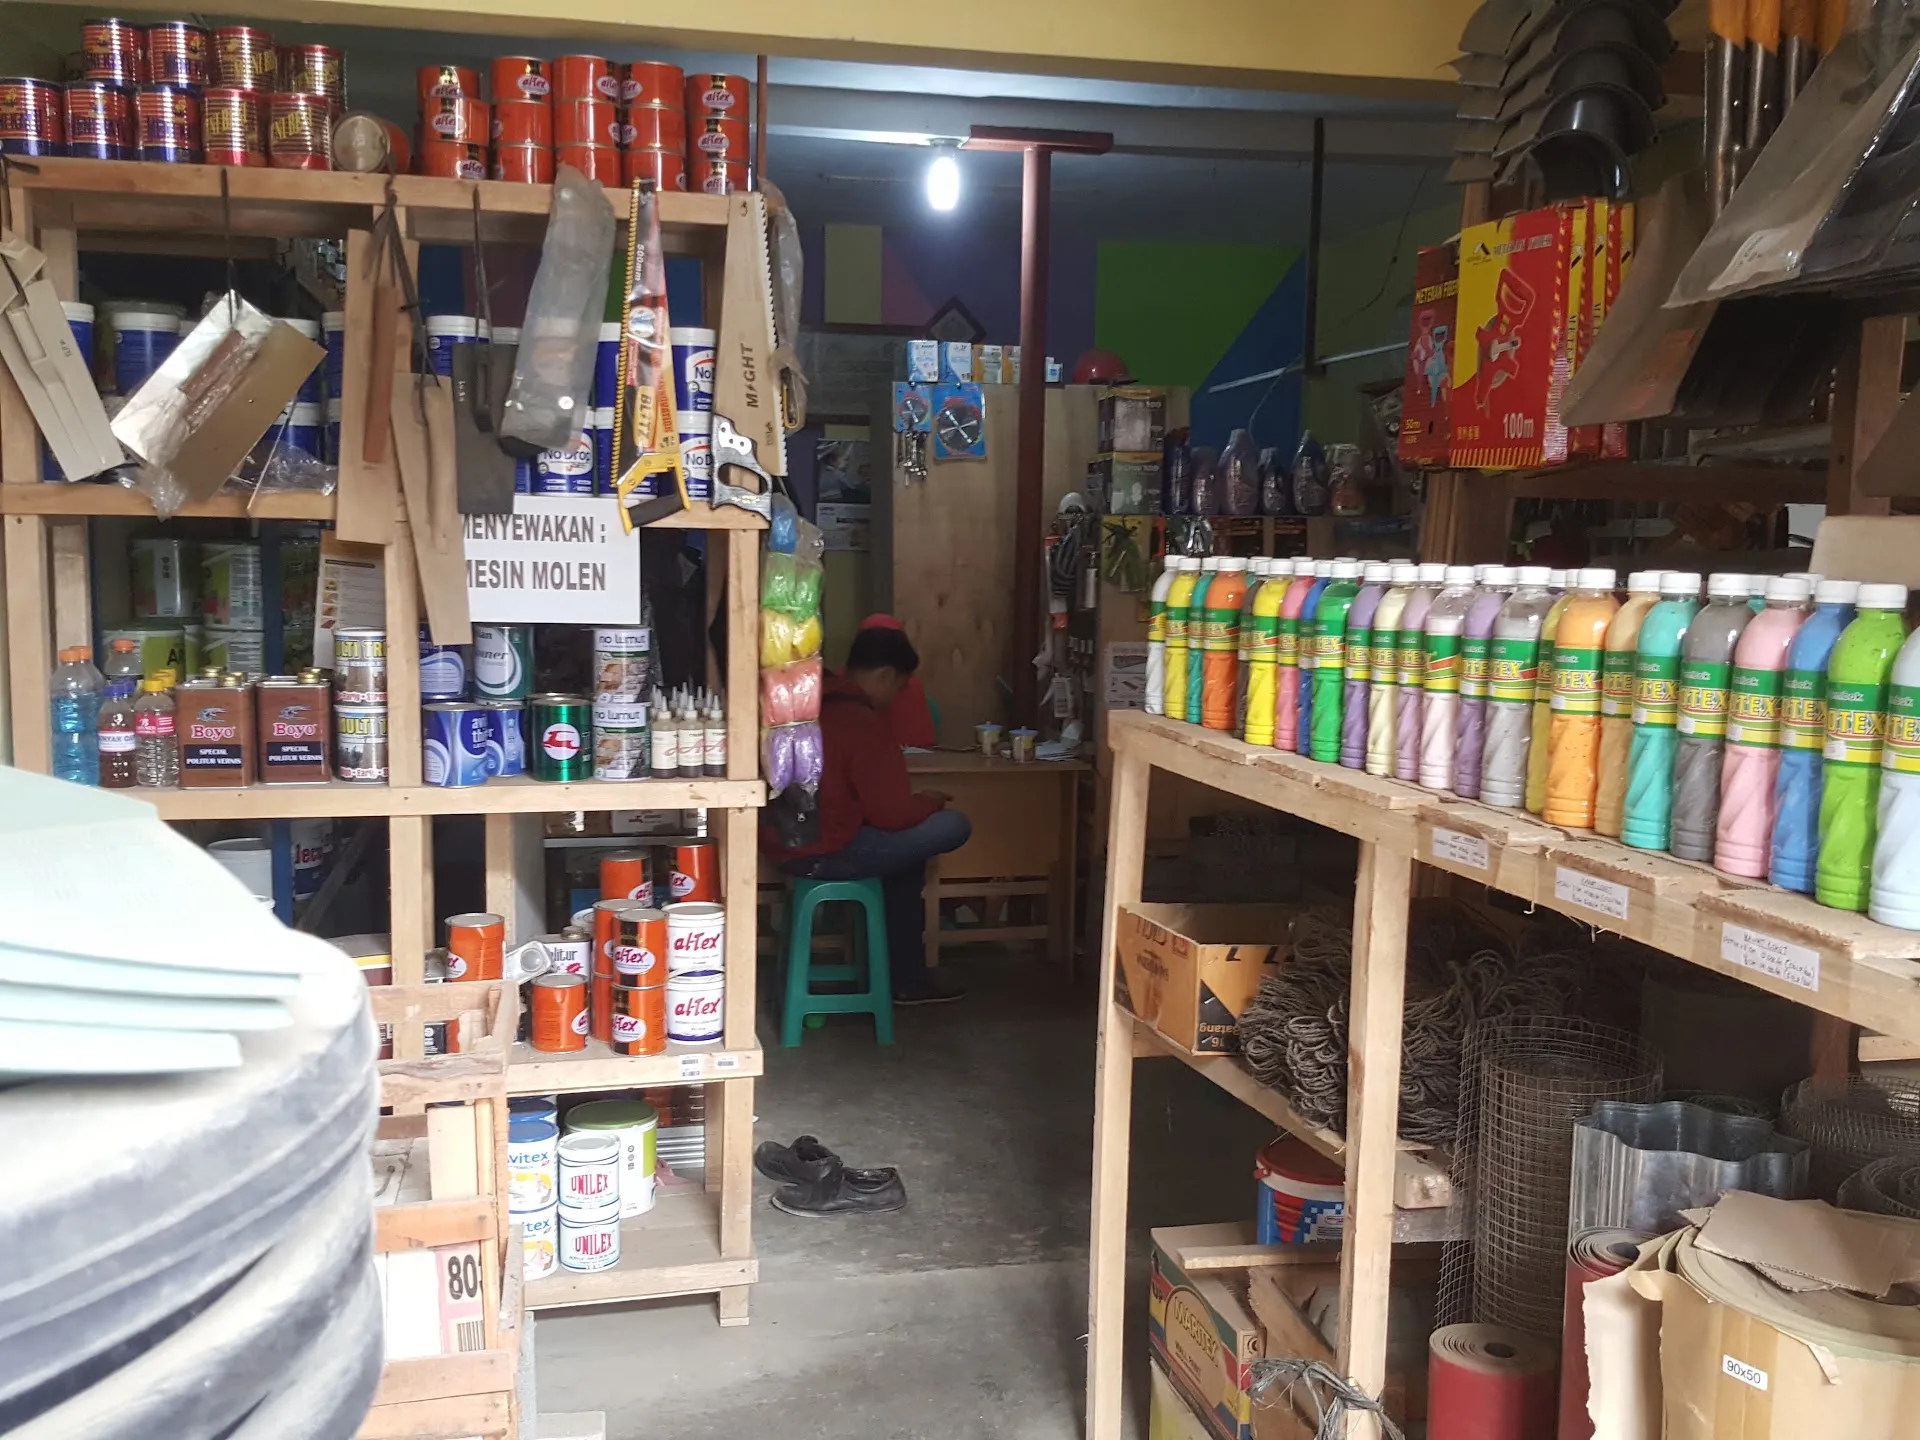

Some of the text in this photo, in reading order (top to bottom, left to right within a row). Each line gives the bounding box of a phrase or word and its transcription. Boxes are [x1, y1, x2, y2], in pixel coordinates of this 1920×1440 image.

[634, 244, 645, 281] 500mm
[1503, 413, 1534, 439] 100m
[532, 561, 607, 591] MOLEN
[191, 725, 235, 741] Boyo
[273, 722, 315, 739] Boyo
[570, 1173, 609, 1196] UNILEX
[574, 1233, 613, 1256] UNILEX
[447, 1254, 478, 1300] 80
[1727, 1360, 1761, 1384] 90x50
